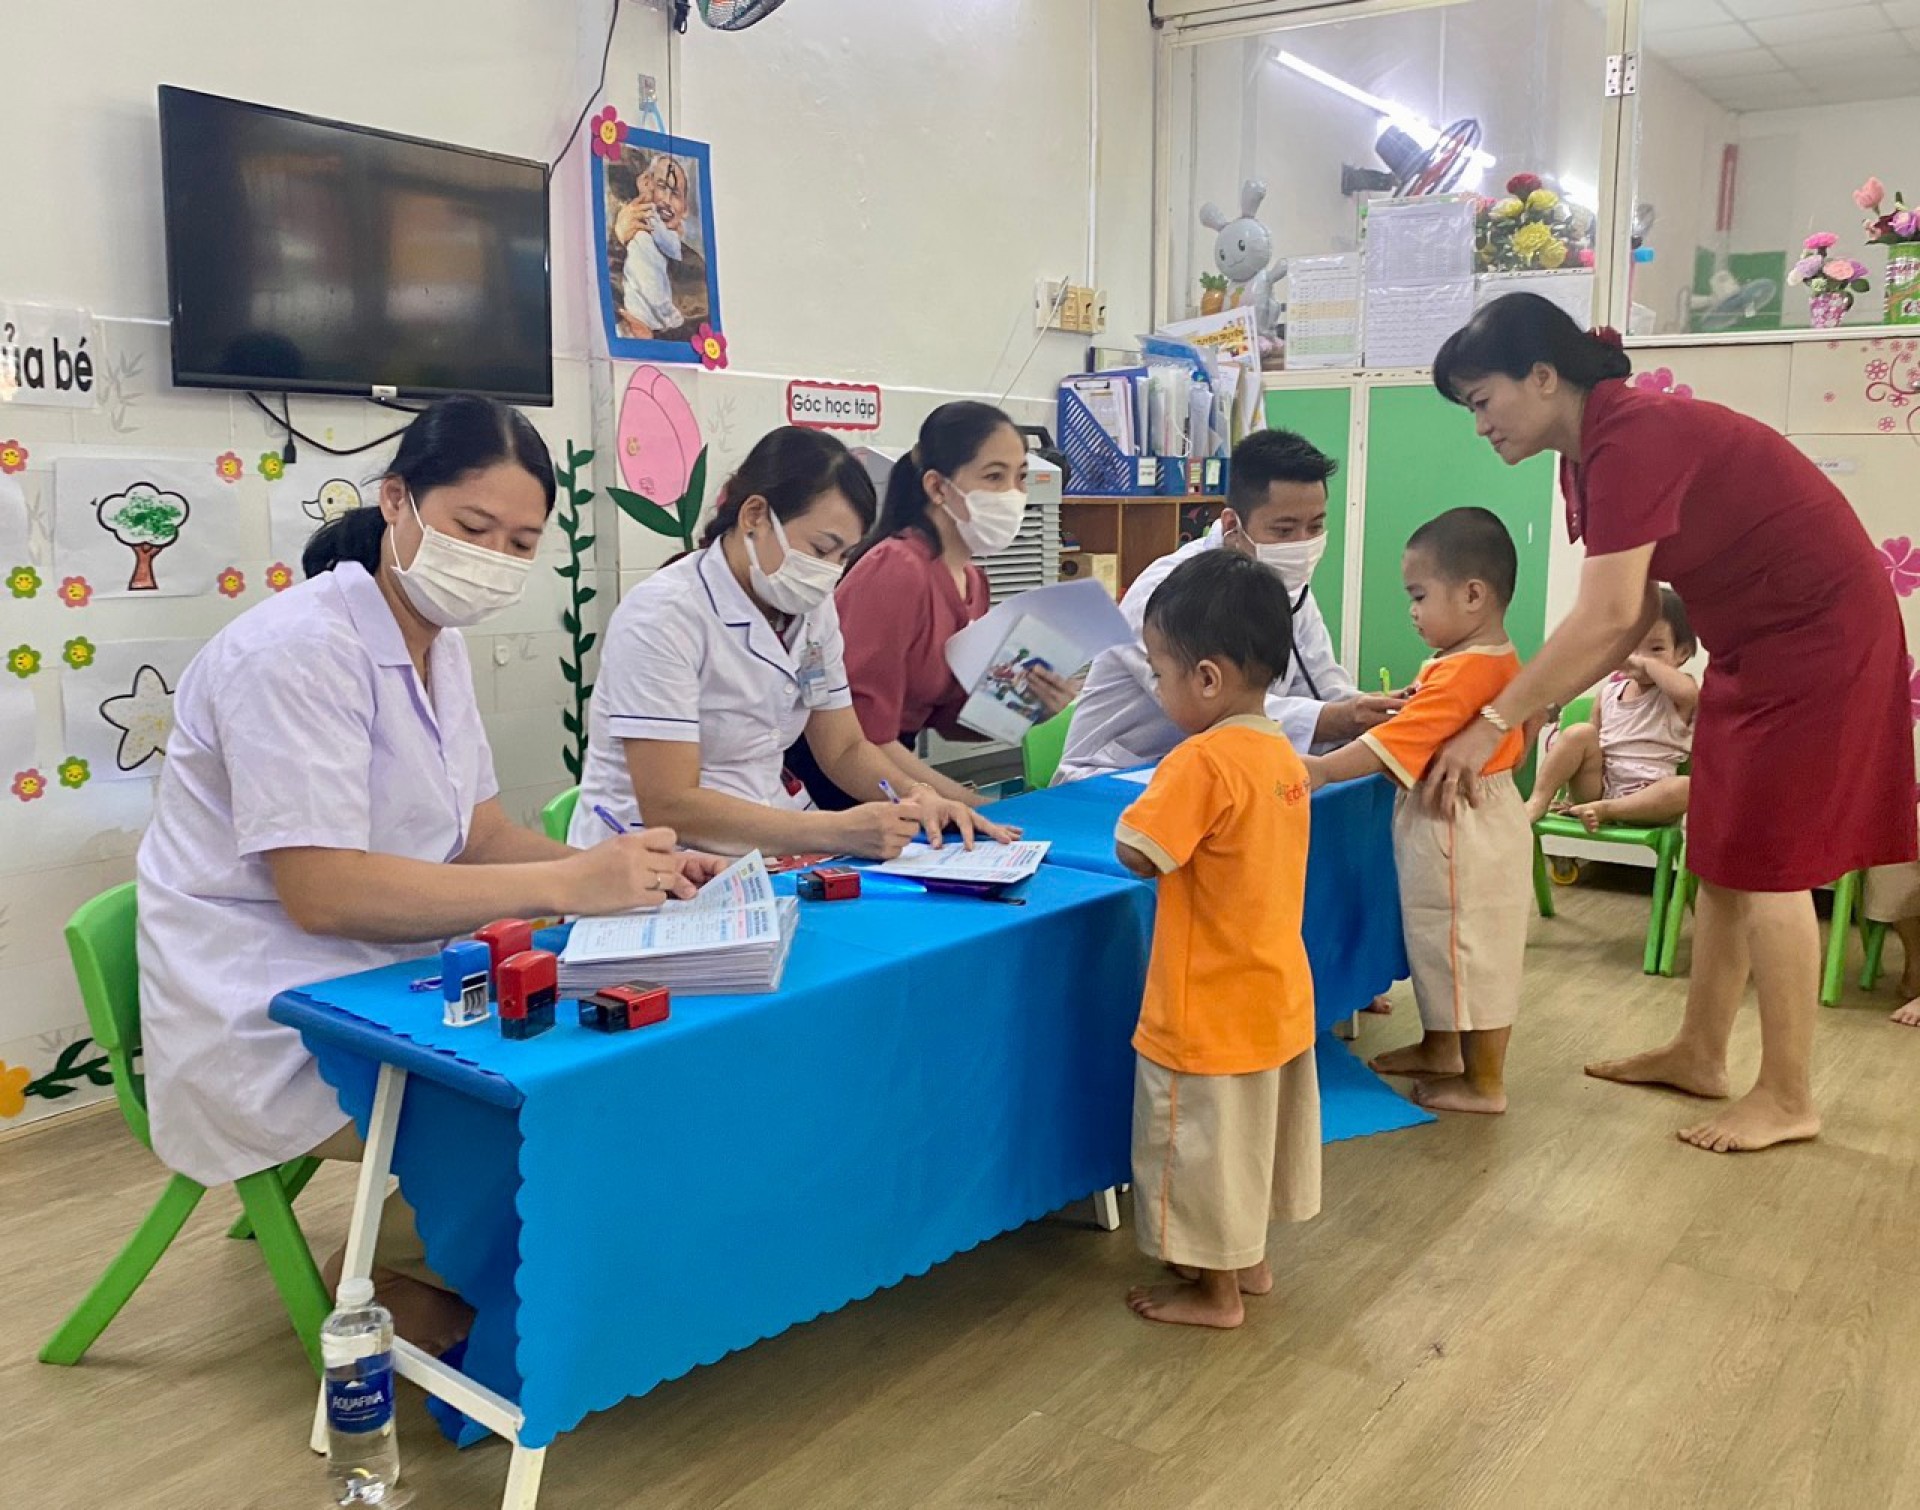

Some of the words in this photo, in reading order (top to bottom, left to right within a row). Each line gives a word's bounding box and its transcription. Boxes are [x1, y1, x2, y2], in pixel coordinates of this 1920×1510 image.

[53, 336, 93, 392] bé
[792, 393, 821, 412] Góc
[825, 396, 851, 417] học
[854, 398, 876, 418] tập
